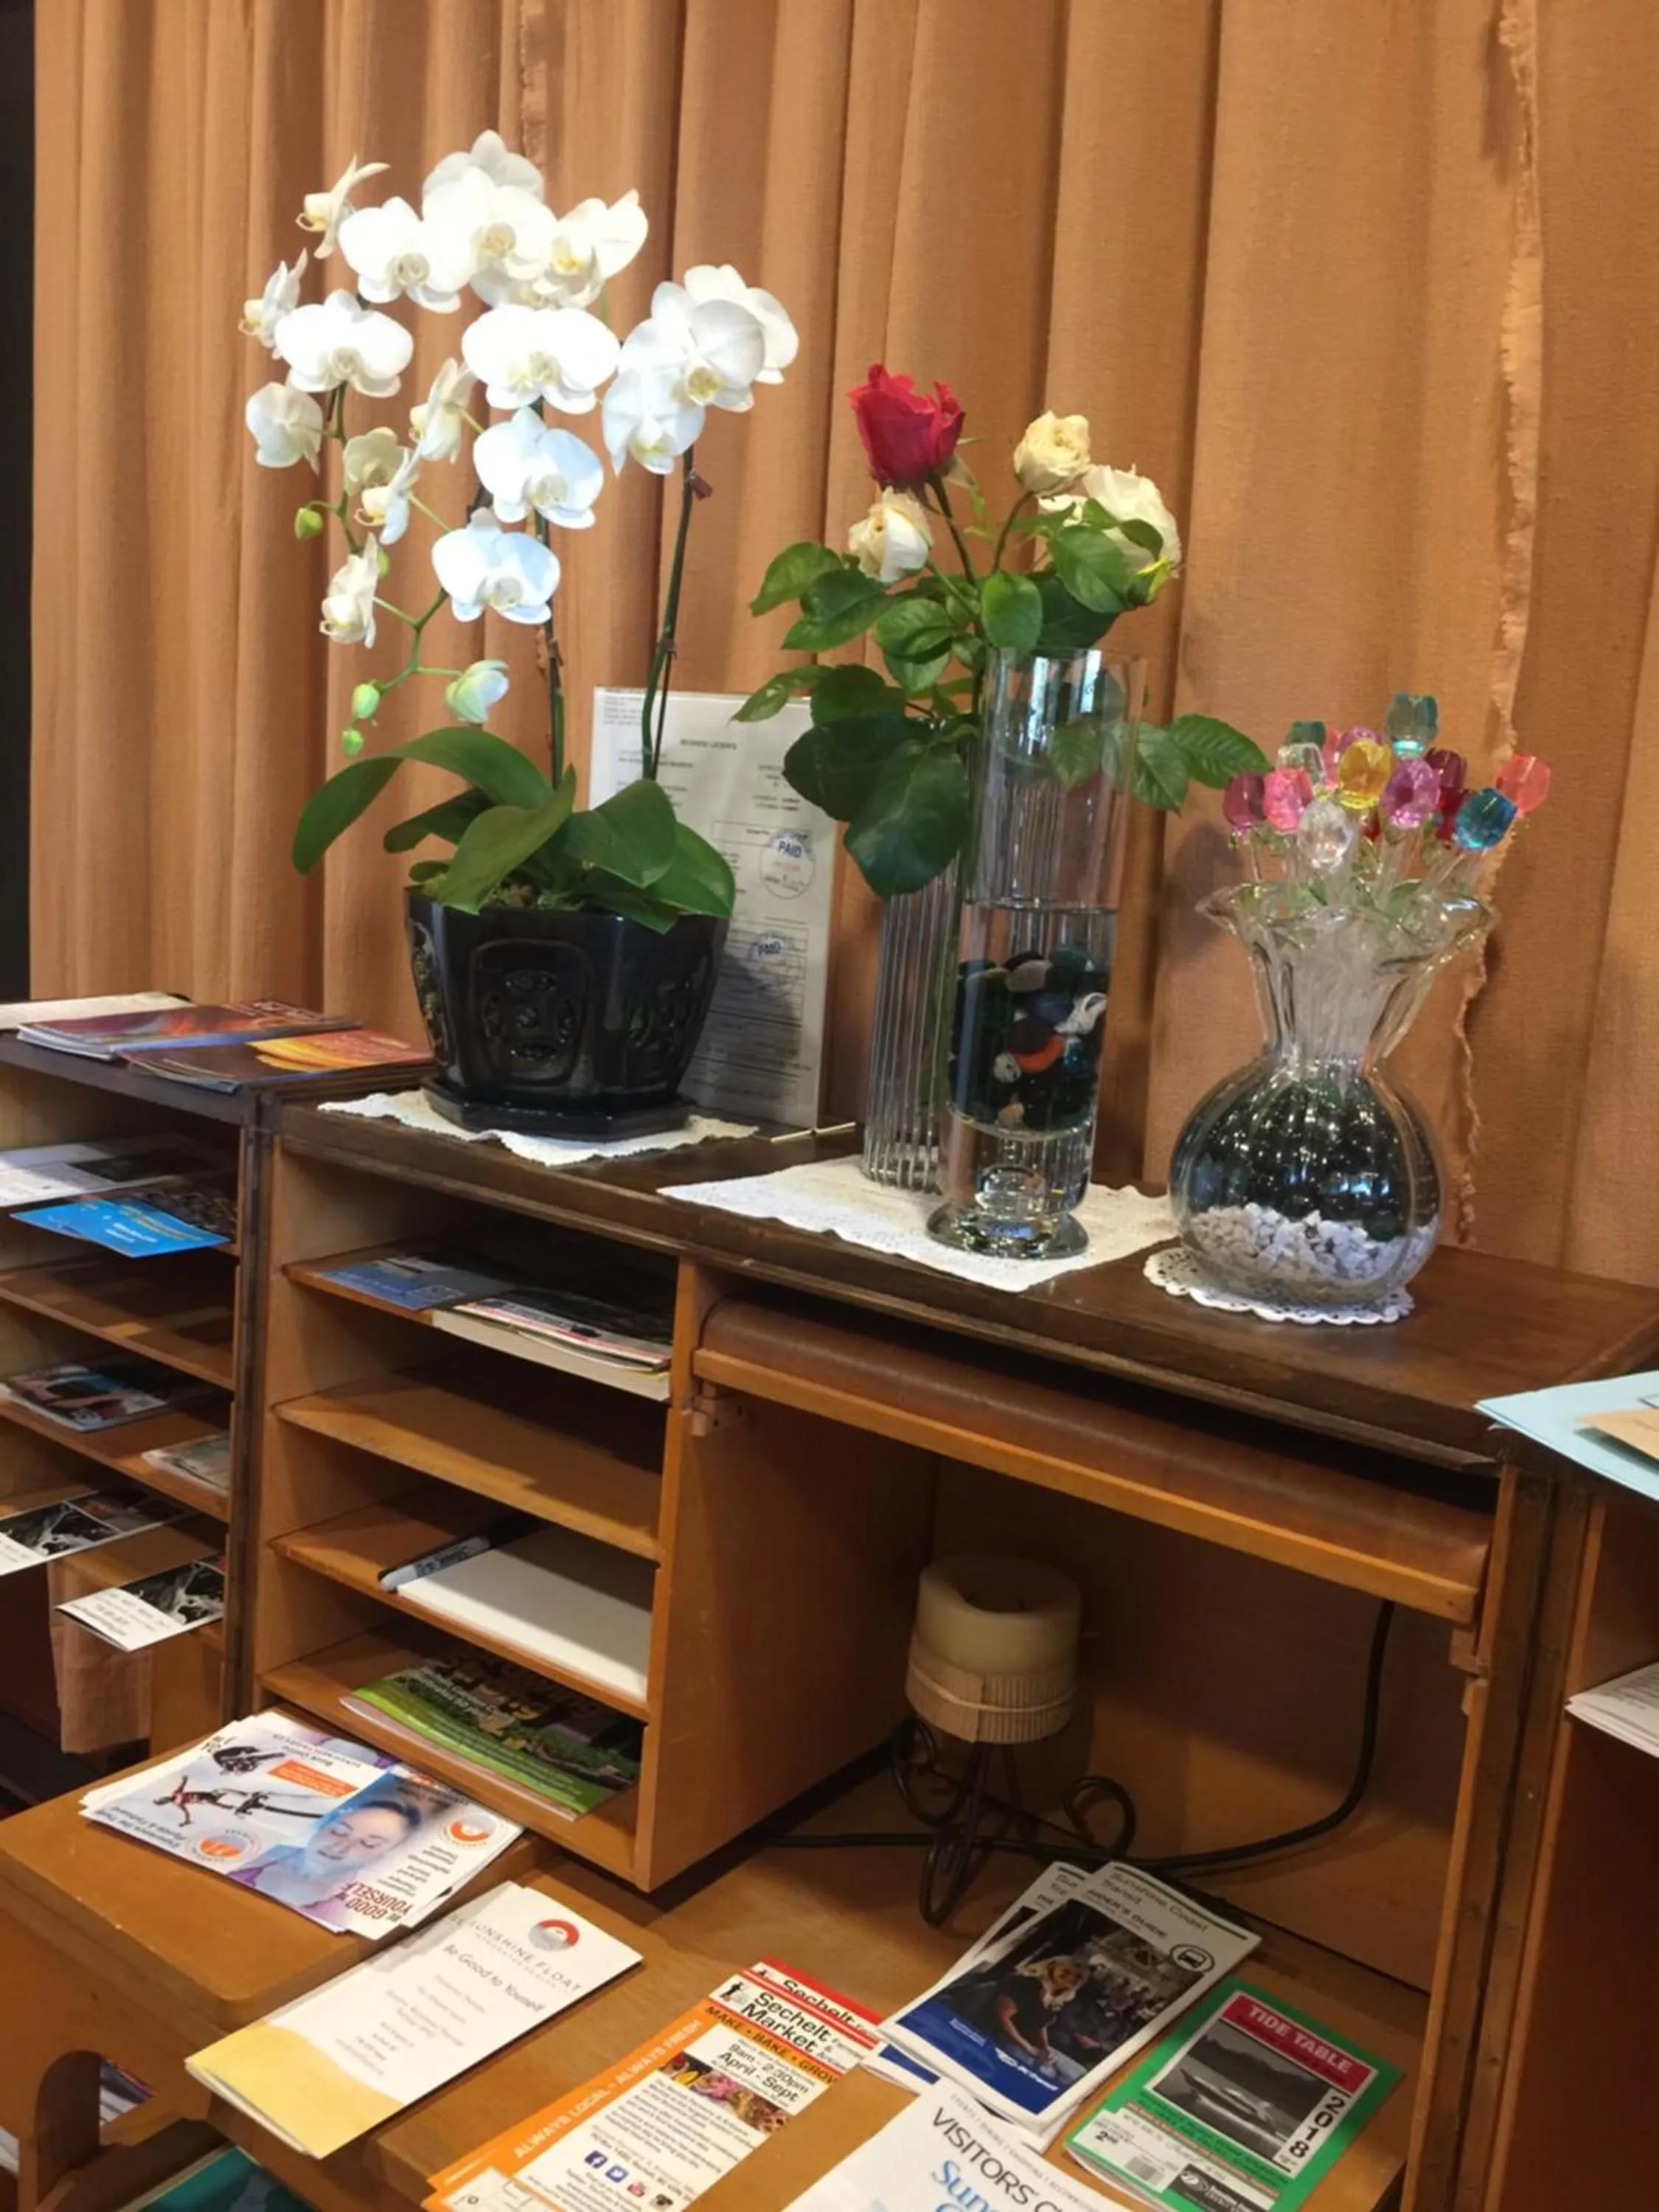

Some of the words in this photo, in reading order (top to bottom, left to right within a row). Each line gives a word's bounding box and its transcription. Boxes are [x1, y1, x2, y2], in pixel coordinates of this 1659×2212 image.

[342, 1881, 414, 1915] YOURSELF
[345, 1899, 388, 1919] GOOD
[458, 1952, 493, 1978] Good
[706, 2005, 742, 2031] MAKE
[752, 2028, 787, 2057] BAKE
[740, 2003, 819, 2053] Market
[754, 1991, 833, 2042] Sechelt
[1248, 2005, 1293, 2037] TIDE
[1293, 2031, 1355, 2073] TABLE
[717, 2051, 757, 2076] April
[762, 2076, 799, 2102] Sept
[513, 2115, 571, 2159] ALWAYS
[568, 2088, 611, 2118] LOCAL
[616, 2046, 667, 2084] ALWAYS
[1289, 2096, 1346, 2158] 2018
